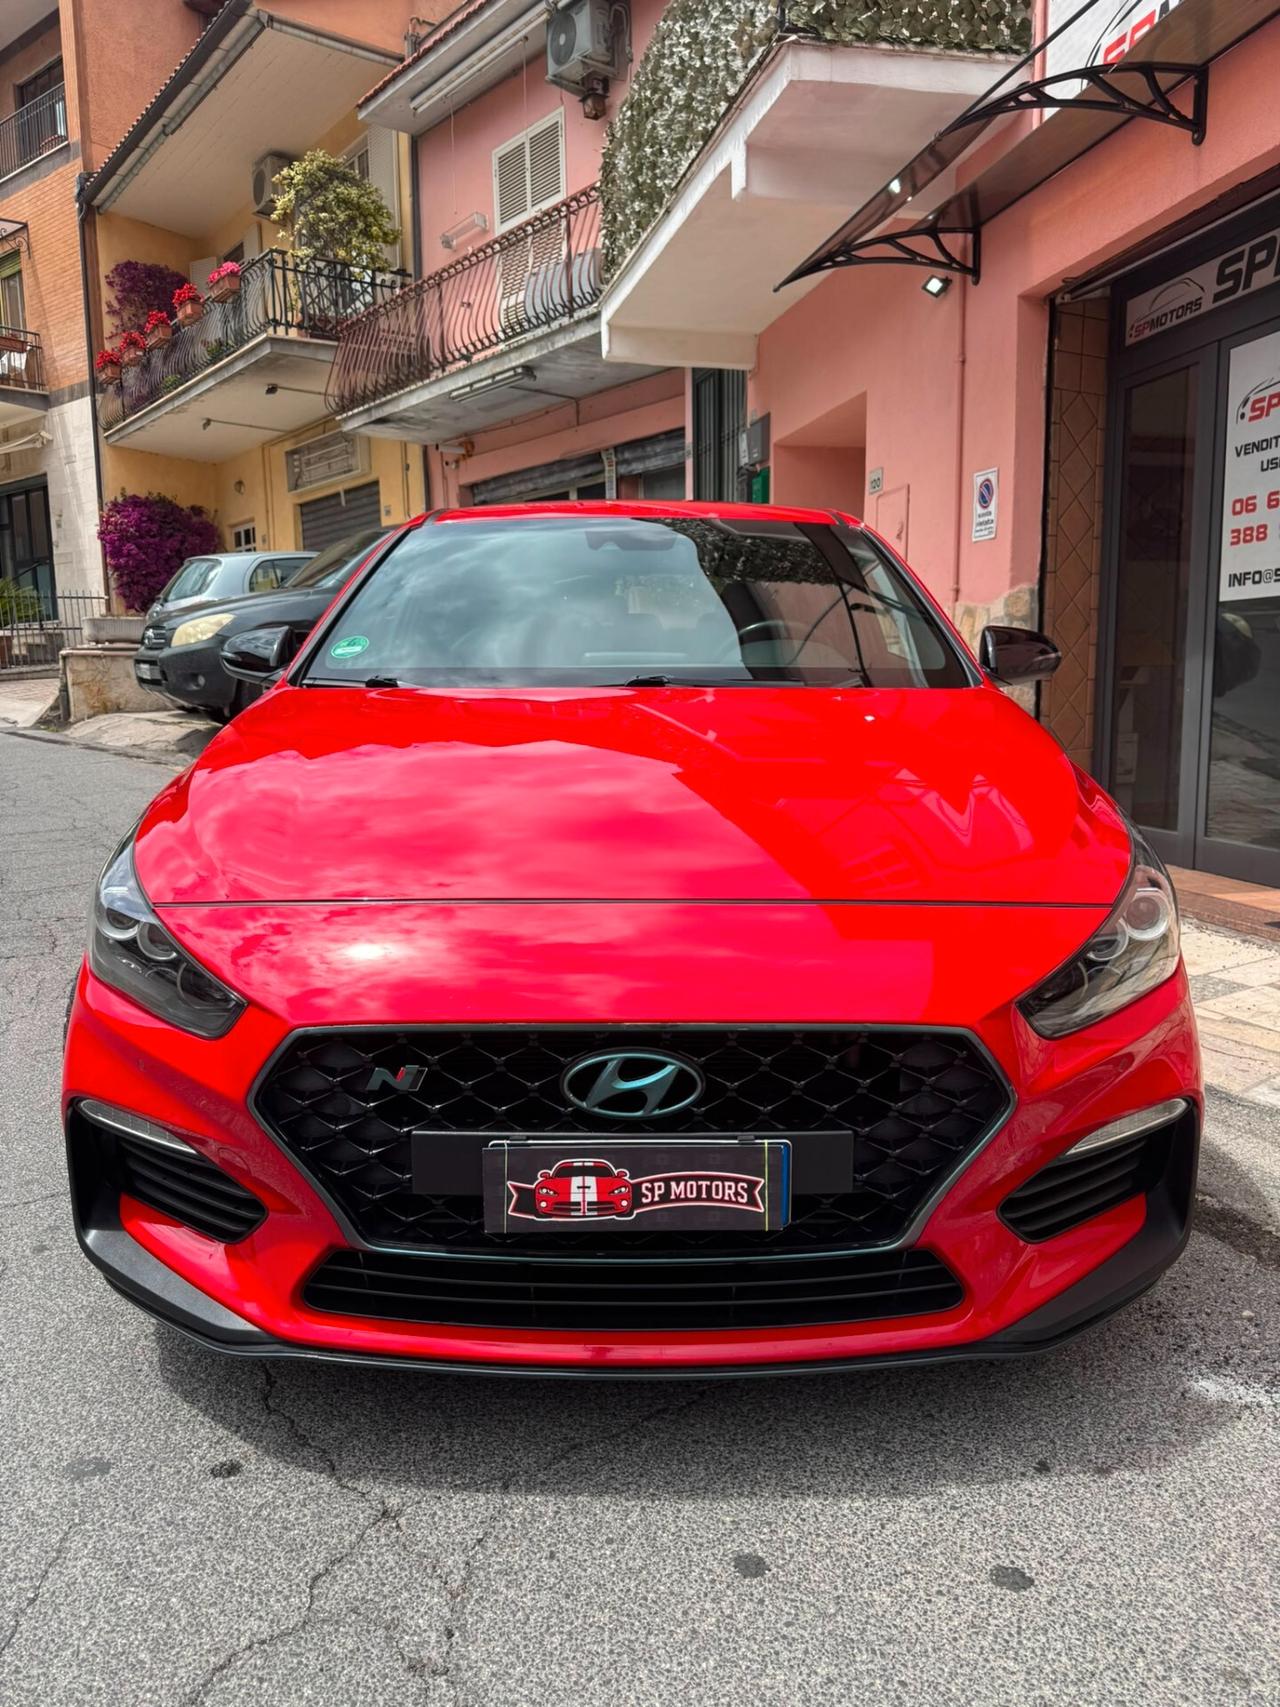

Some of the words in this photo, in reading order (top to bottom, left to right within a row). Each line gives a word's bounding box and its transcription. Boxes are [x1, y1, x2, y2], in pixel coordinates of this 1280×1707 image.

[1212, 235, 1280, 304] SP
[1261, 457, 1280, 472] US
[1232, 495, 1257, 516] 06
[1230, 523, 1268, 546] 388
[641, 1181, 665, 1203] SP
[670, 1180, 748, 1203] MOTORS
